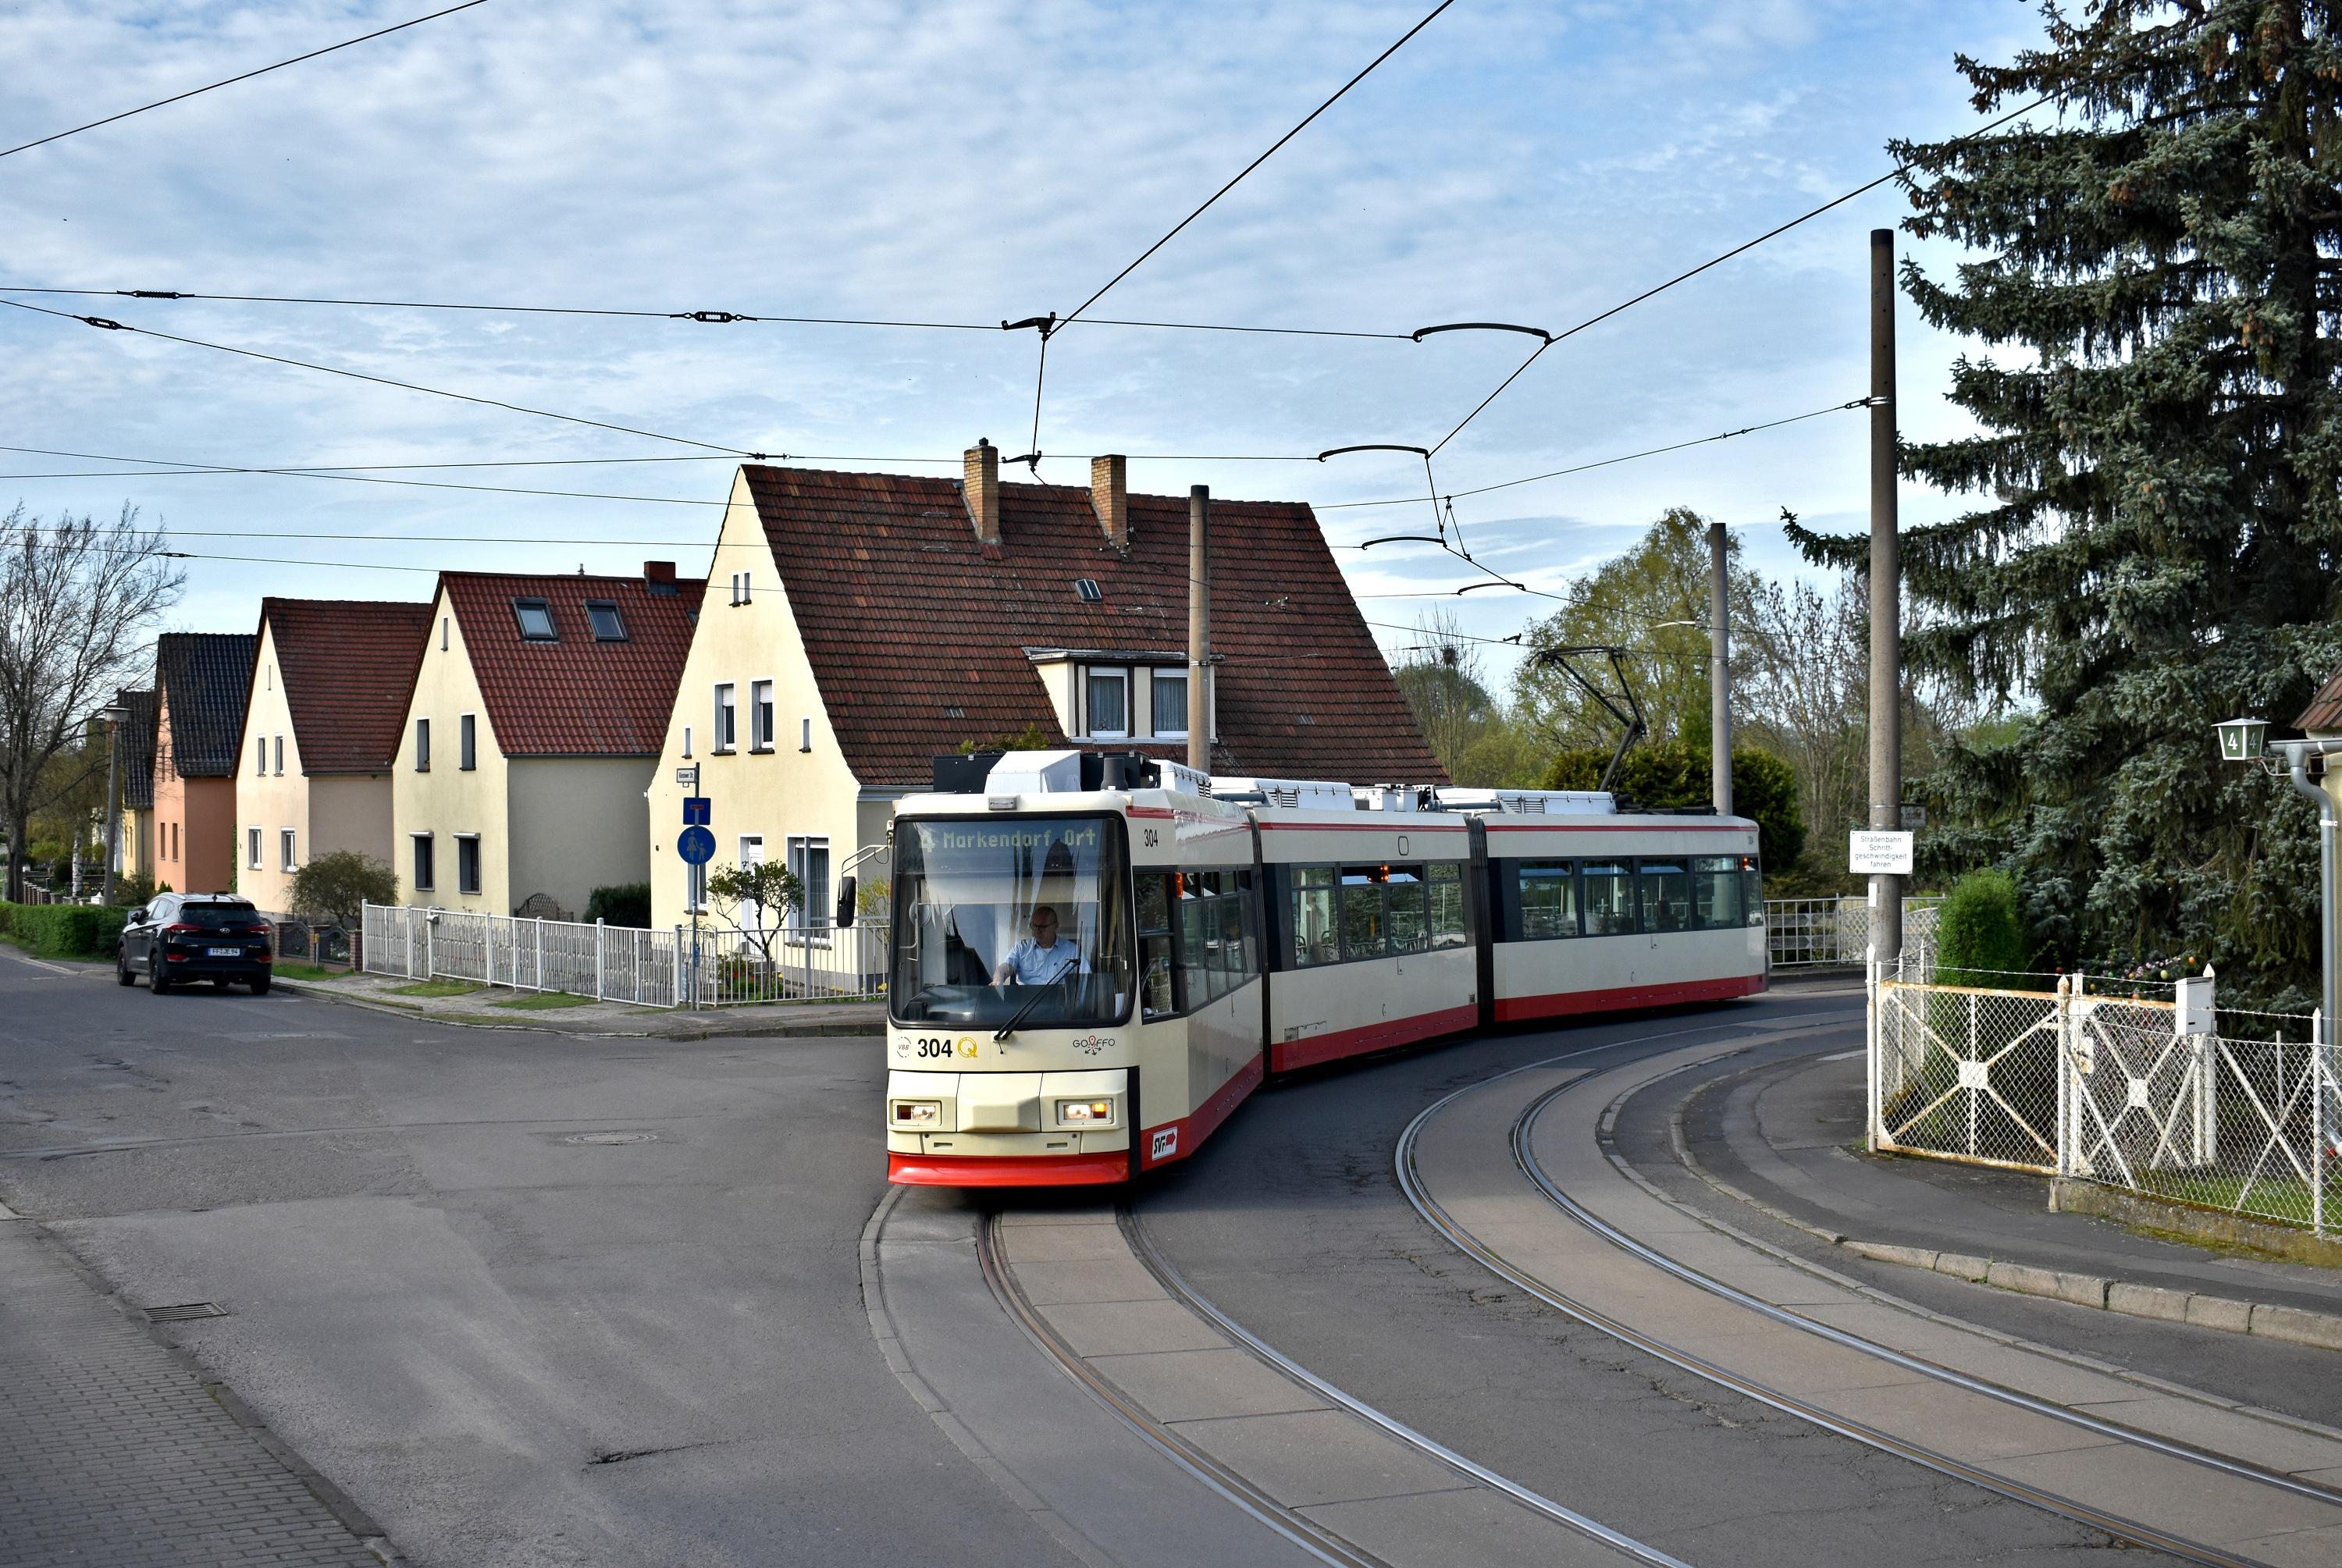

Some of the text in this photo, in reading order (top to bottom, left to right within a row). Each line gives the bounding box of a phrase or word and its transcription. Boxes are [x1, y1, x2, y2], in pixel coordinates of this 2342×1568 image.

[2227, 731, 2238, 750] 4
[2249, 731, 2257, 749] 4
[920, 829, 1096, 852] 4 Markendorf Ort
[1144, 828, 1159, 848] 304
[917, 1038, 953, 1058] 304
